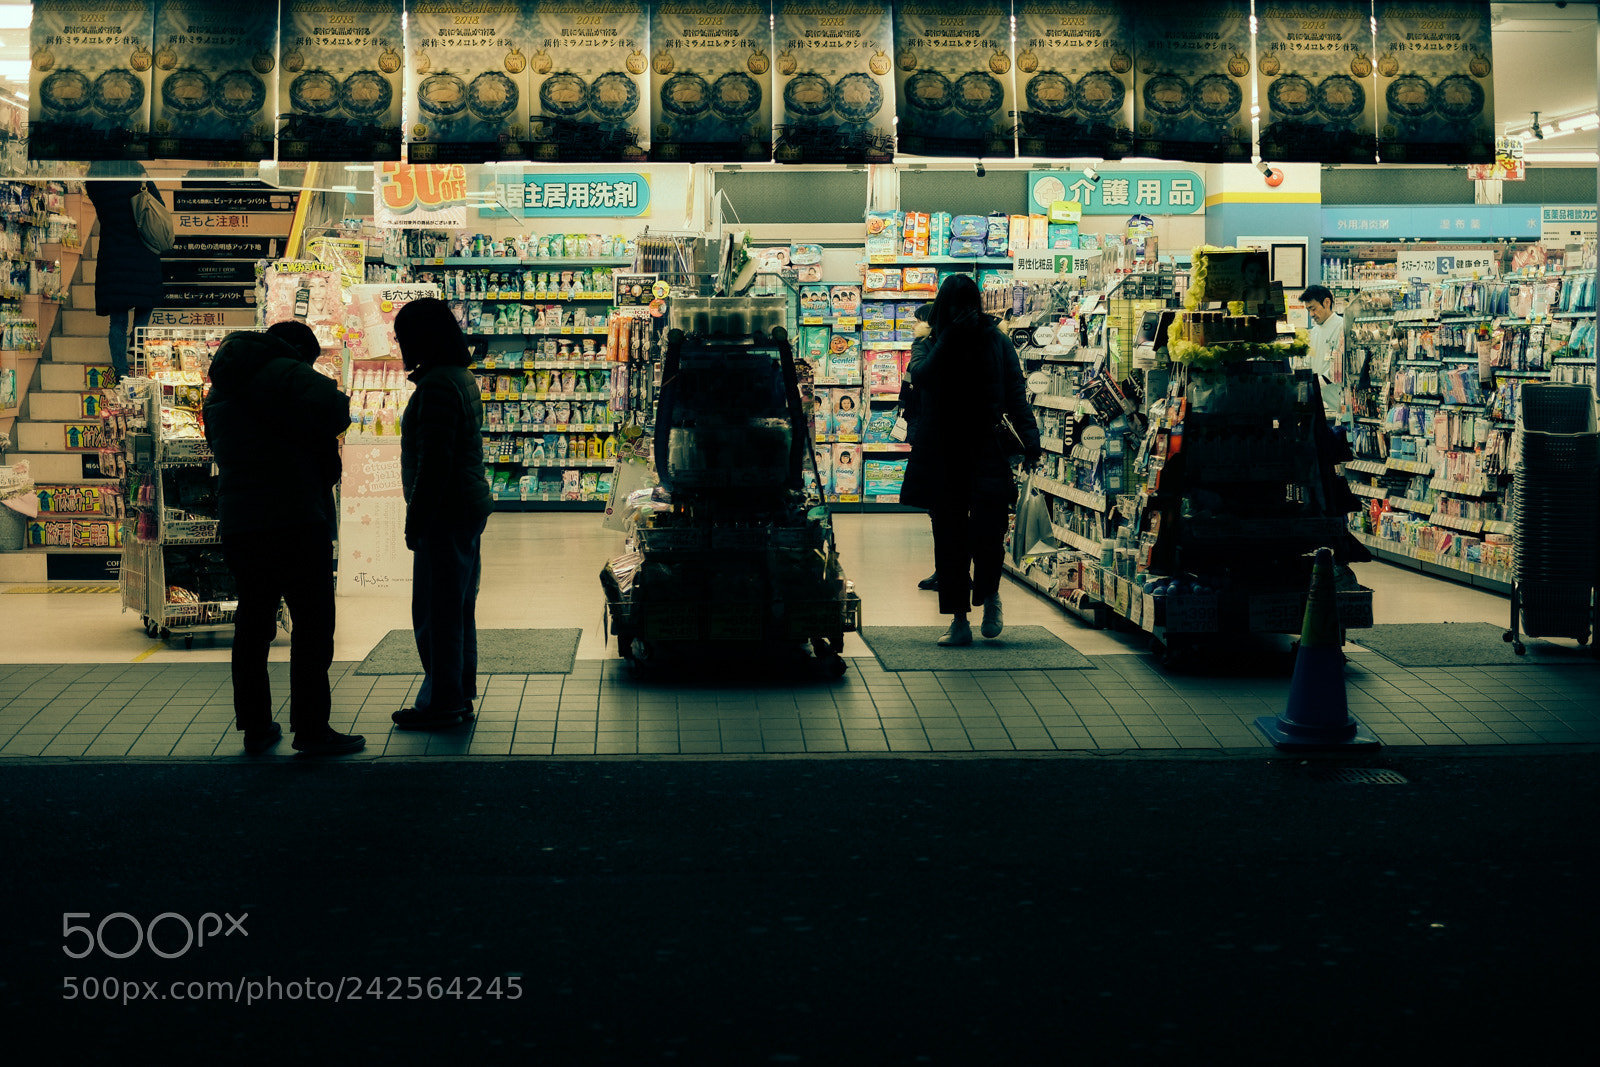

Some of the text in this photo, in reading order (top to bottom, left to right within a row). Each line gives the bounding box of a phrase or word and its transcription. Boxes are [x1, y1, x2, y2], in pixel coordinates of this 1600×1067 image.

[442, 180, 466, 200] OFF
[1070, 178, 1195, 206] 介護用品
[1018, 258, 1052, 270] 男性化粧品
[1441, 258, 1450, 272] 3
[152, 312, 224, 326] 足もと注意!!
[1064, 416, 1074, 446] uno
[364, 462, 400, 472] ettusa
[371, 481, 403, 490] mouss
